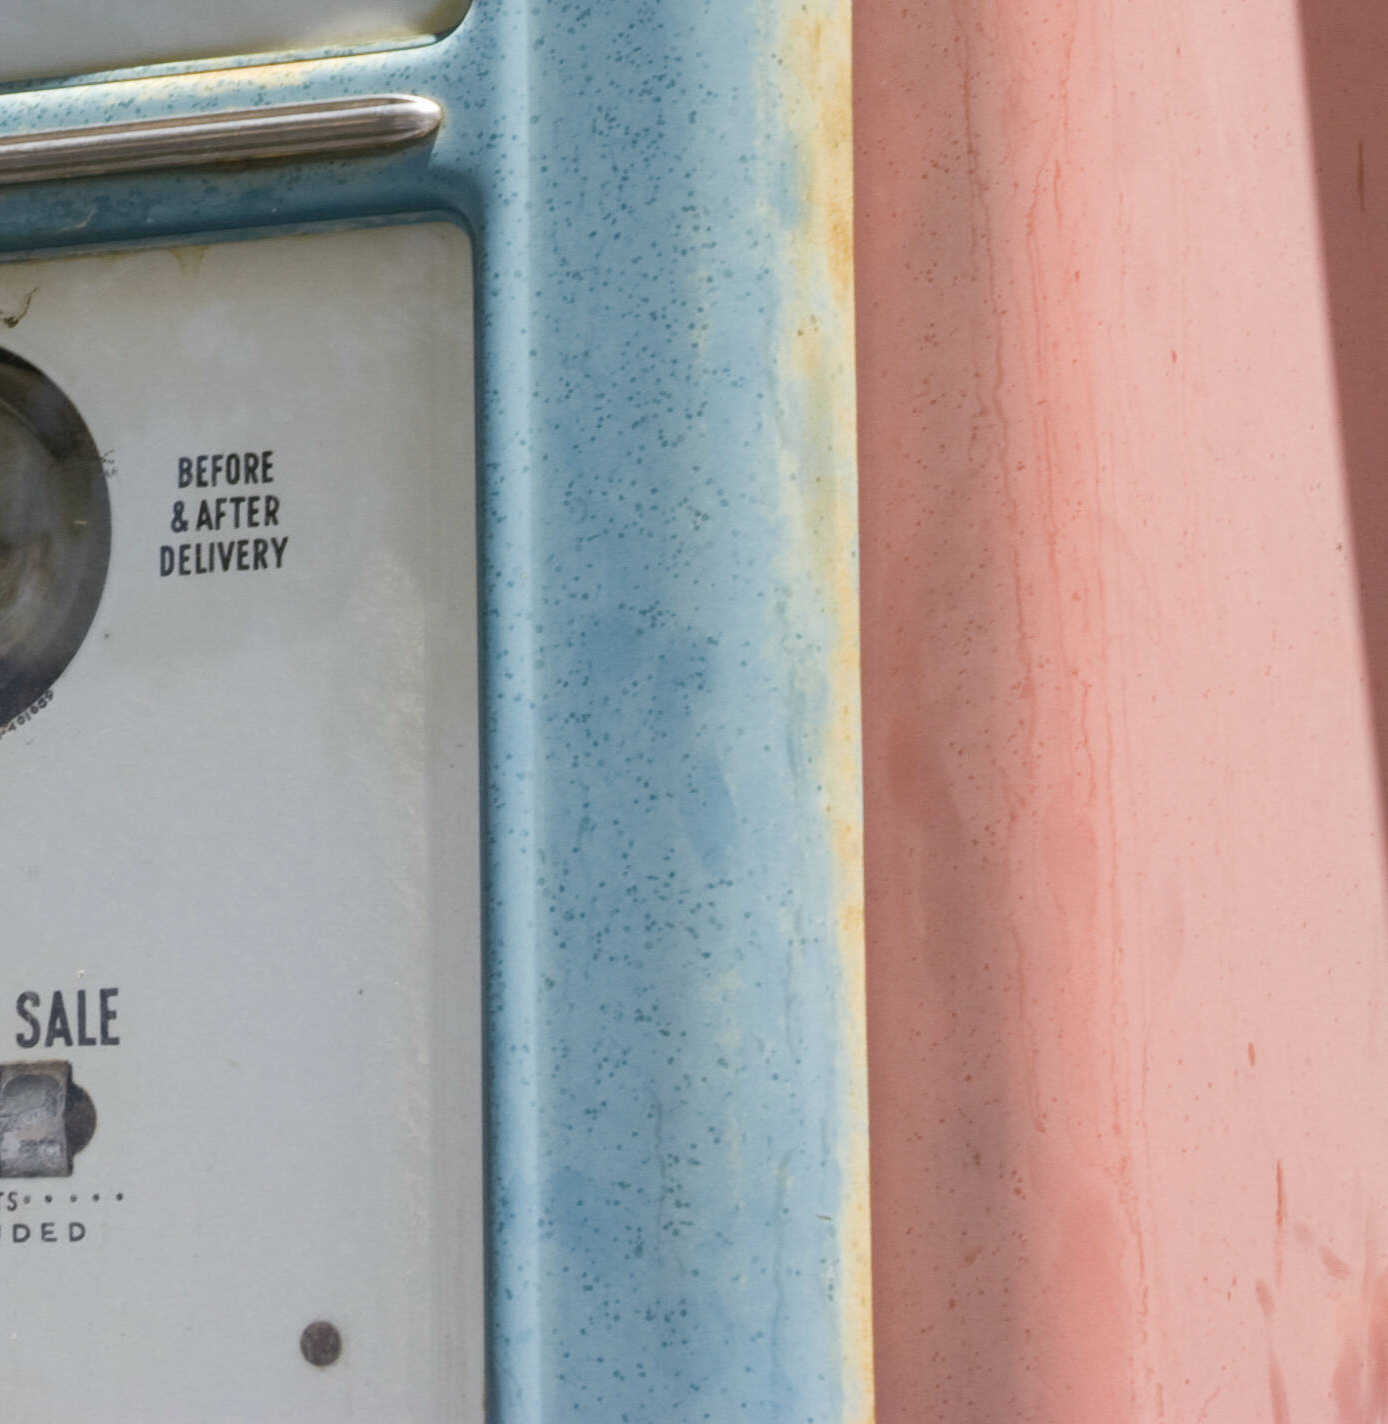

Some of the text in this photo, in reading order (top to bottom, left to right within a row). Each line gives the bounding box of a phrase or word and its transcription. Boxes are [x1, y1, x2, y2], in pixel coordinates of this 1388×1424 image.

[178, 450, 274, 488] BEFORE
[171, 494, 280, 533] & AFTER
[160, 536, 289, 577] DELIVERY
[16, 987, 120, 1049] SALE
